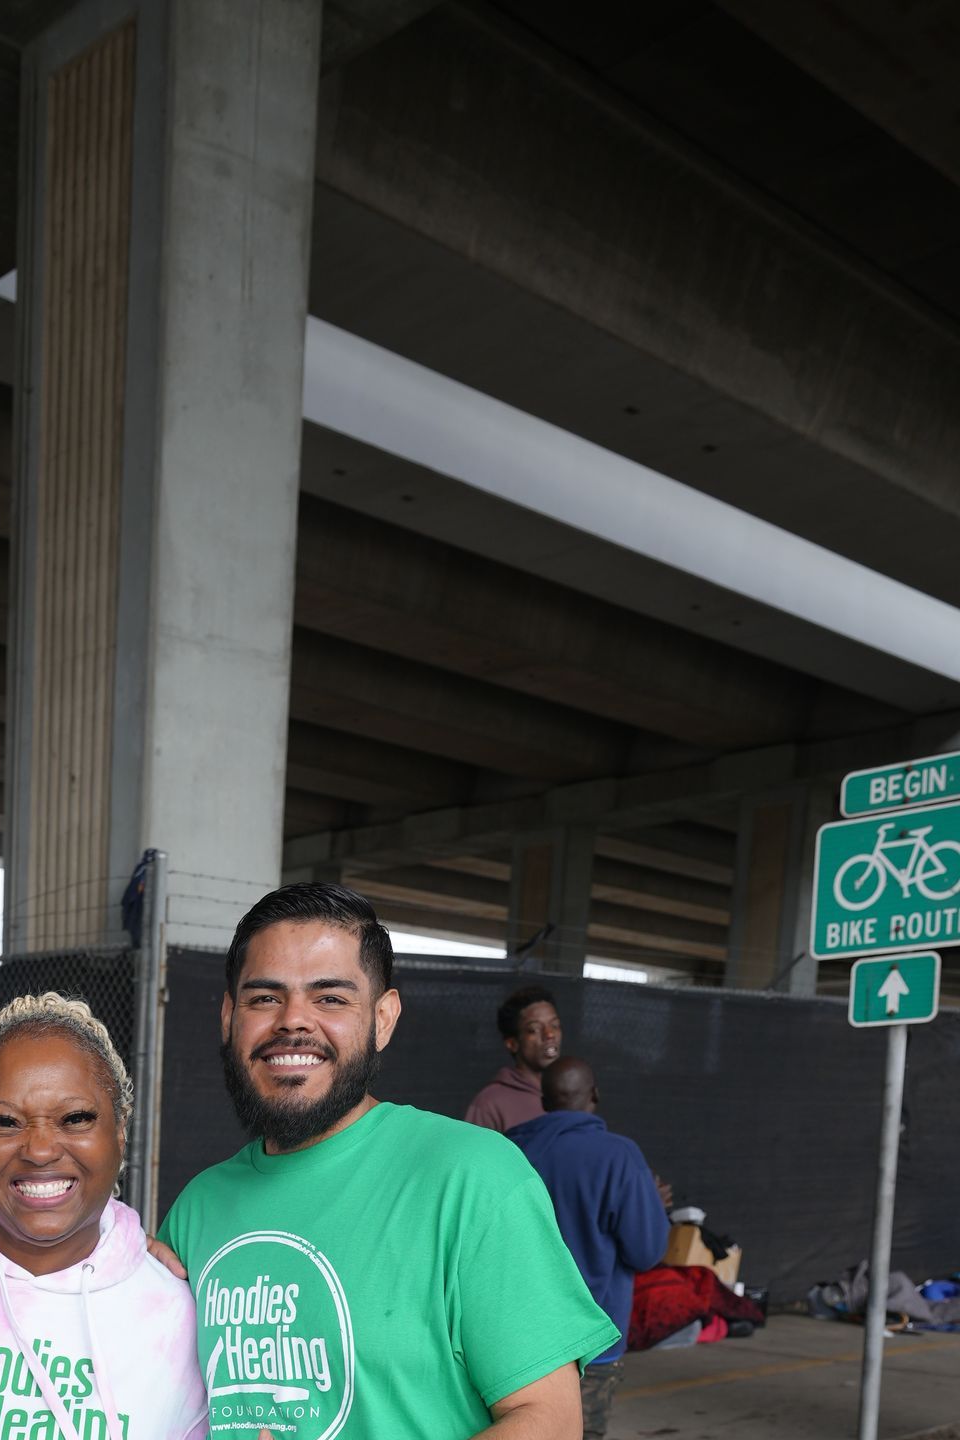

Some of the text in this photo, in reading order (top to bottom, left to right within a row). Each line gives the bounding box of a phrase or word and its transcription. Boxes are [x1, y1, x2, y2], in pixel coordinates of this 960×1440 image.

[869, 764, 948, 805] BEGIN
[826, 918, 878, 949] BIKE
[204, 1275, 300, 1327] Hoodies
[225, 1325, 332, 1392] Healing
